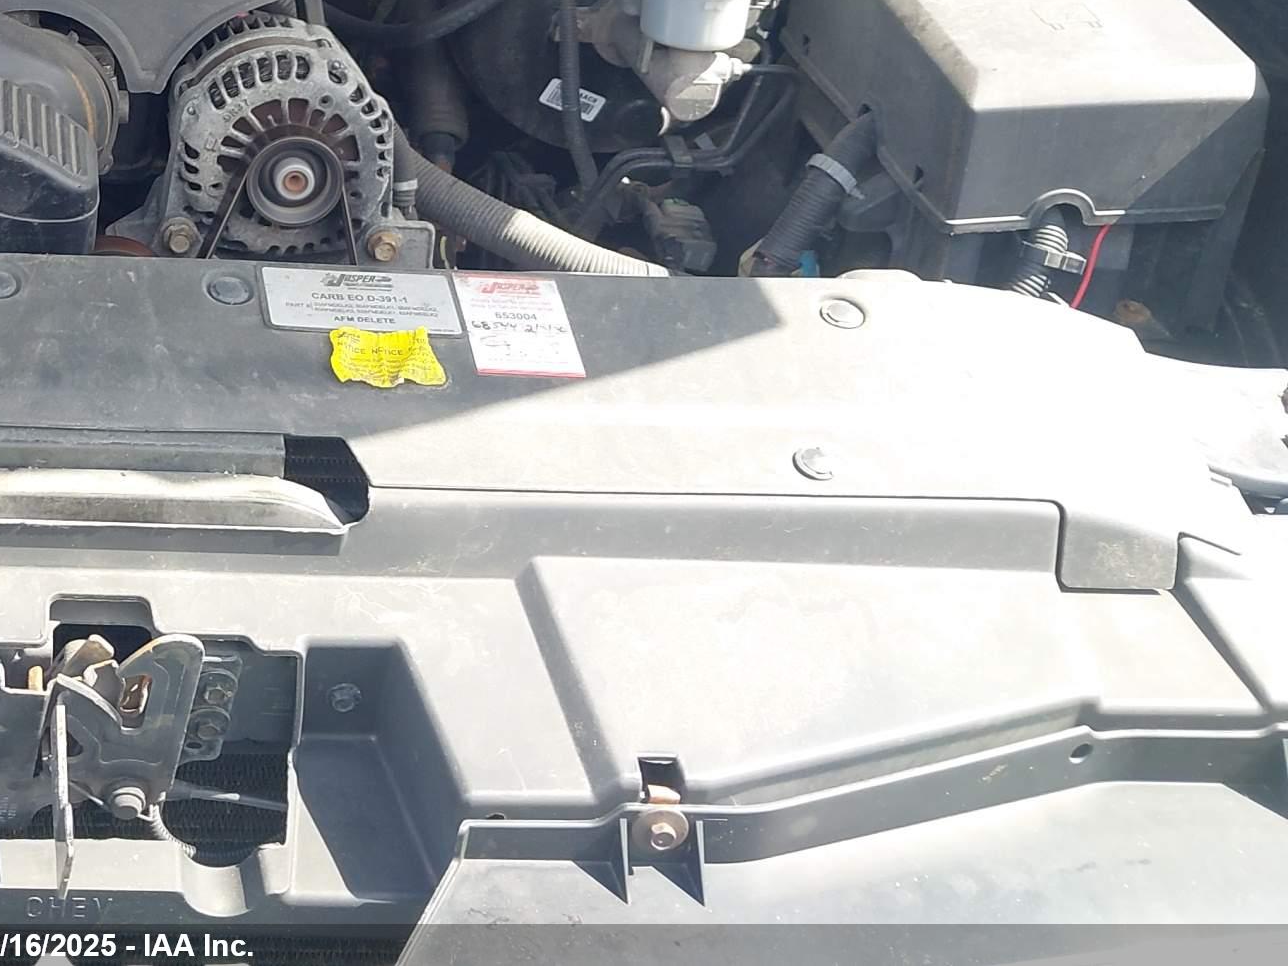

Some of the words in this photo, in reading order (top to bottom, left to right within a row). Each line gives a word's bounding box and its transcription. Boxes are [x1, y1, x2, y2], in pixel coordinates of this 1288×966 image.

[311, 292, 344, 301] CARB
[348, 293, 364, 301] EO
[367, 294, 408, 304] D-391-1
[334, 315, 355, 323] AFM
[358, 316, 396, 324] DELETE
